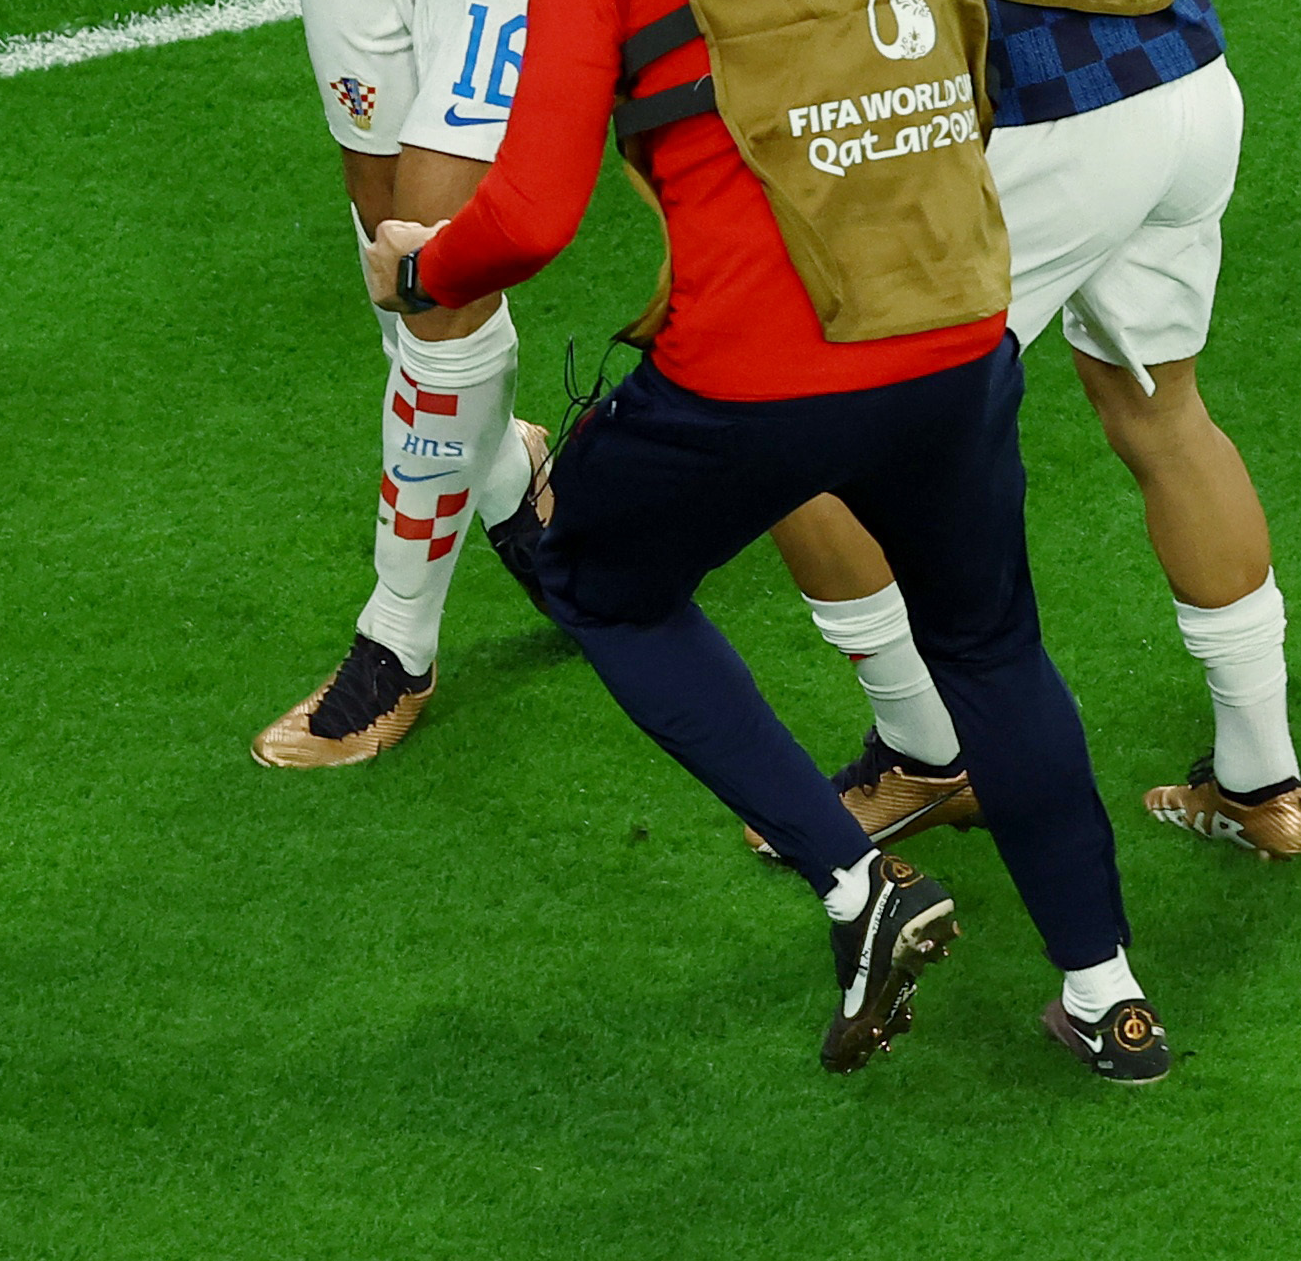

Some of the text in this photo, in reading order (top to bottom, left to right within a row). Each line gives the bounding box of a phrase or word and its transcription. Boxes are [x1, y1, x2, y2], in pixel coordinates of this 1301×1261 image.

[451, 2, 527, 109] 16
[788, 98, 862, 137] FIFA
[859, 78, 957, 123] WORLD
